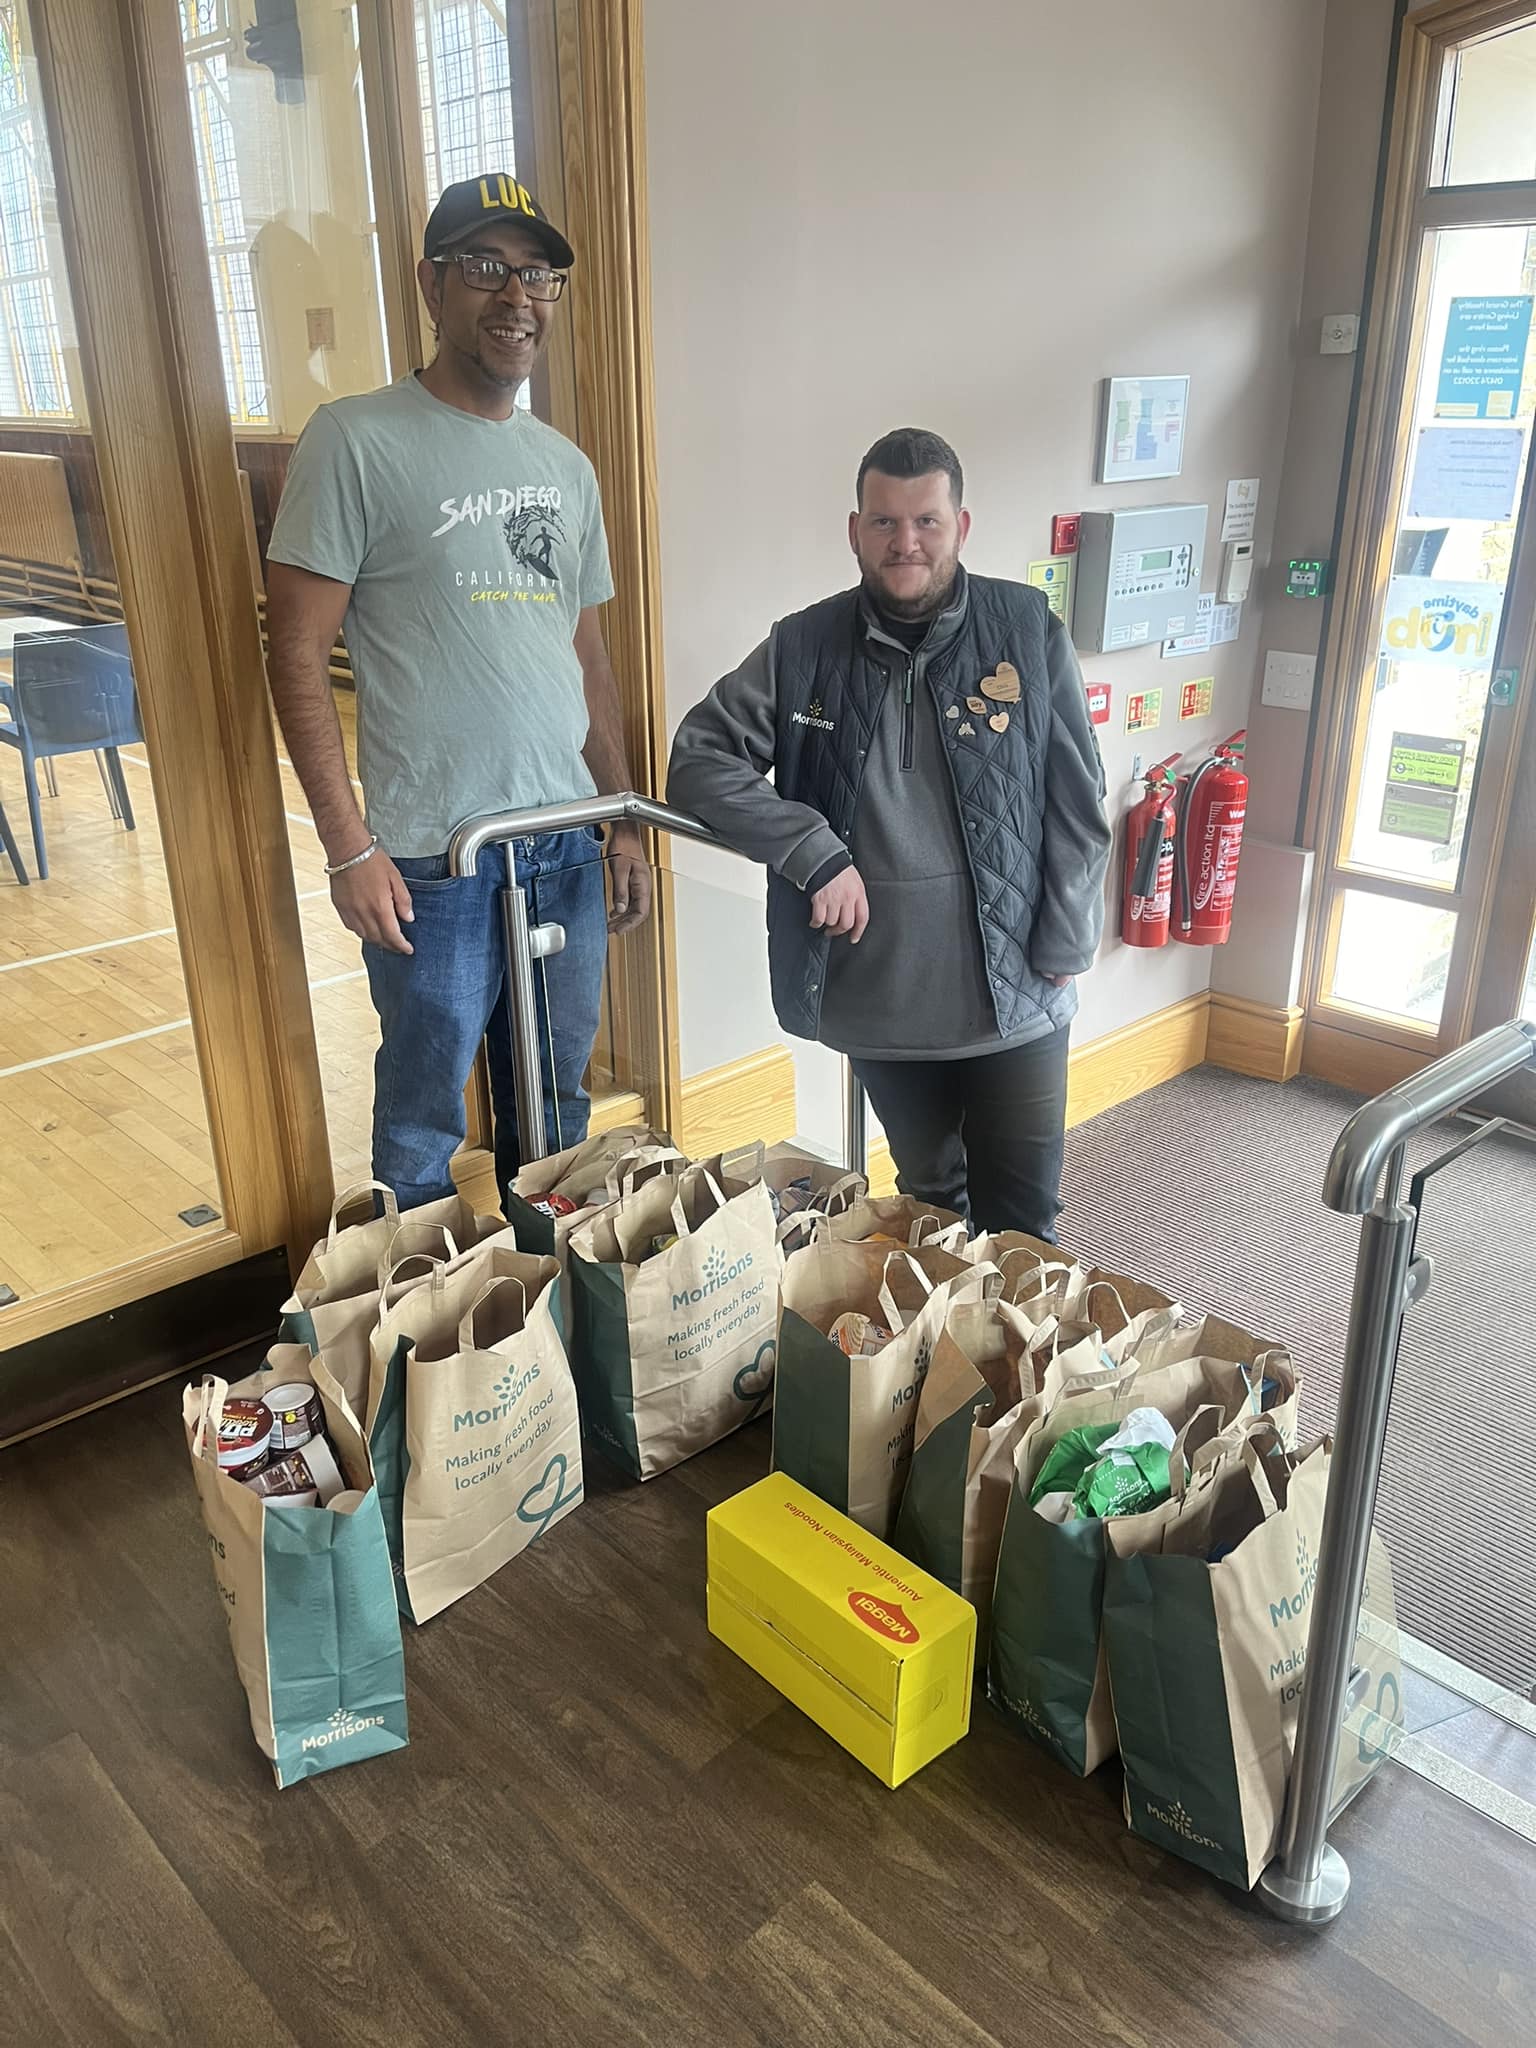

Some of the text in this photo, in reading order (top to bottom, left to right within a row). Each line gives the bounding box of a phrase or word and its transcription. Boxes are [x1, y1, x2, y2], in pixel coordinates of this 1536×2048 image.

[430, 485, 562, 538] SAN DIEGO
[455, 570, 563, 590] CALIFORNI
[471, 591, 558, 603] CATCH THE WAVE
[1201, 844, 1213, 879] action
[672, 1251, 753, 1312] Morrisons
[667, 1276, 765, 1346] Making fresh food
[674, 1302, 762, 1361] locally everyday
[453, 1362, 541, 1432] Morrisons
[446, 1389, 554, 1472] Making fresh food
[455, 1460, 503, 1491] locally
[506, 1416, 553, 1465] everyday
[783, 1502, 923, 1603] Authentic Malaysian Noodles
[855, 1596, 911, 1639] Maggi
[1269, 1557, 1318, 1628] Morriso
[1269, 1645, 1306, 1680] Maki
[302, 1715, 385, 1752] Morrisons
[1146, 1802, 1225, 1852] Morrisons
